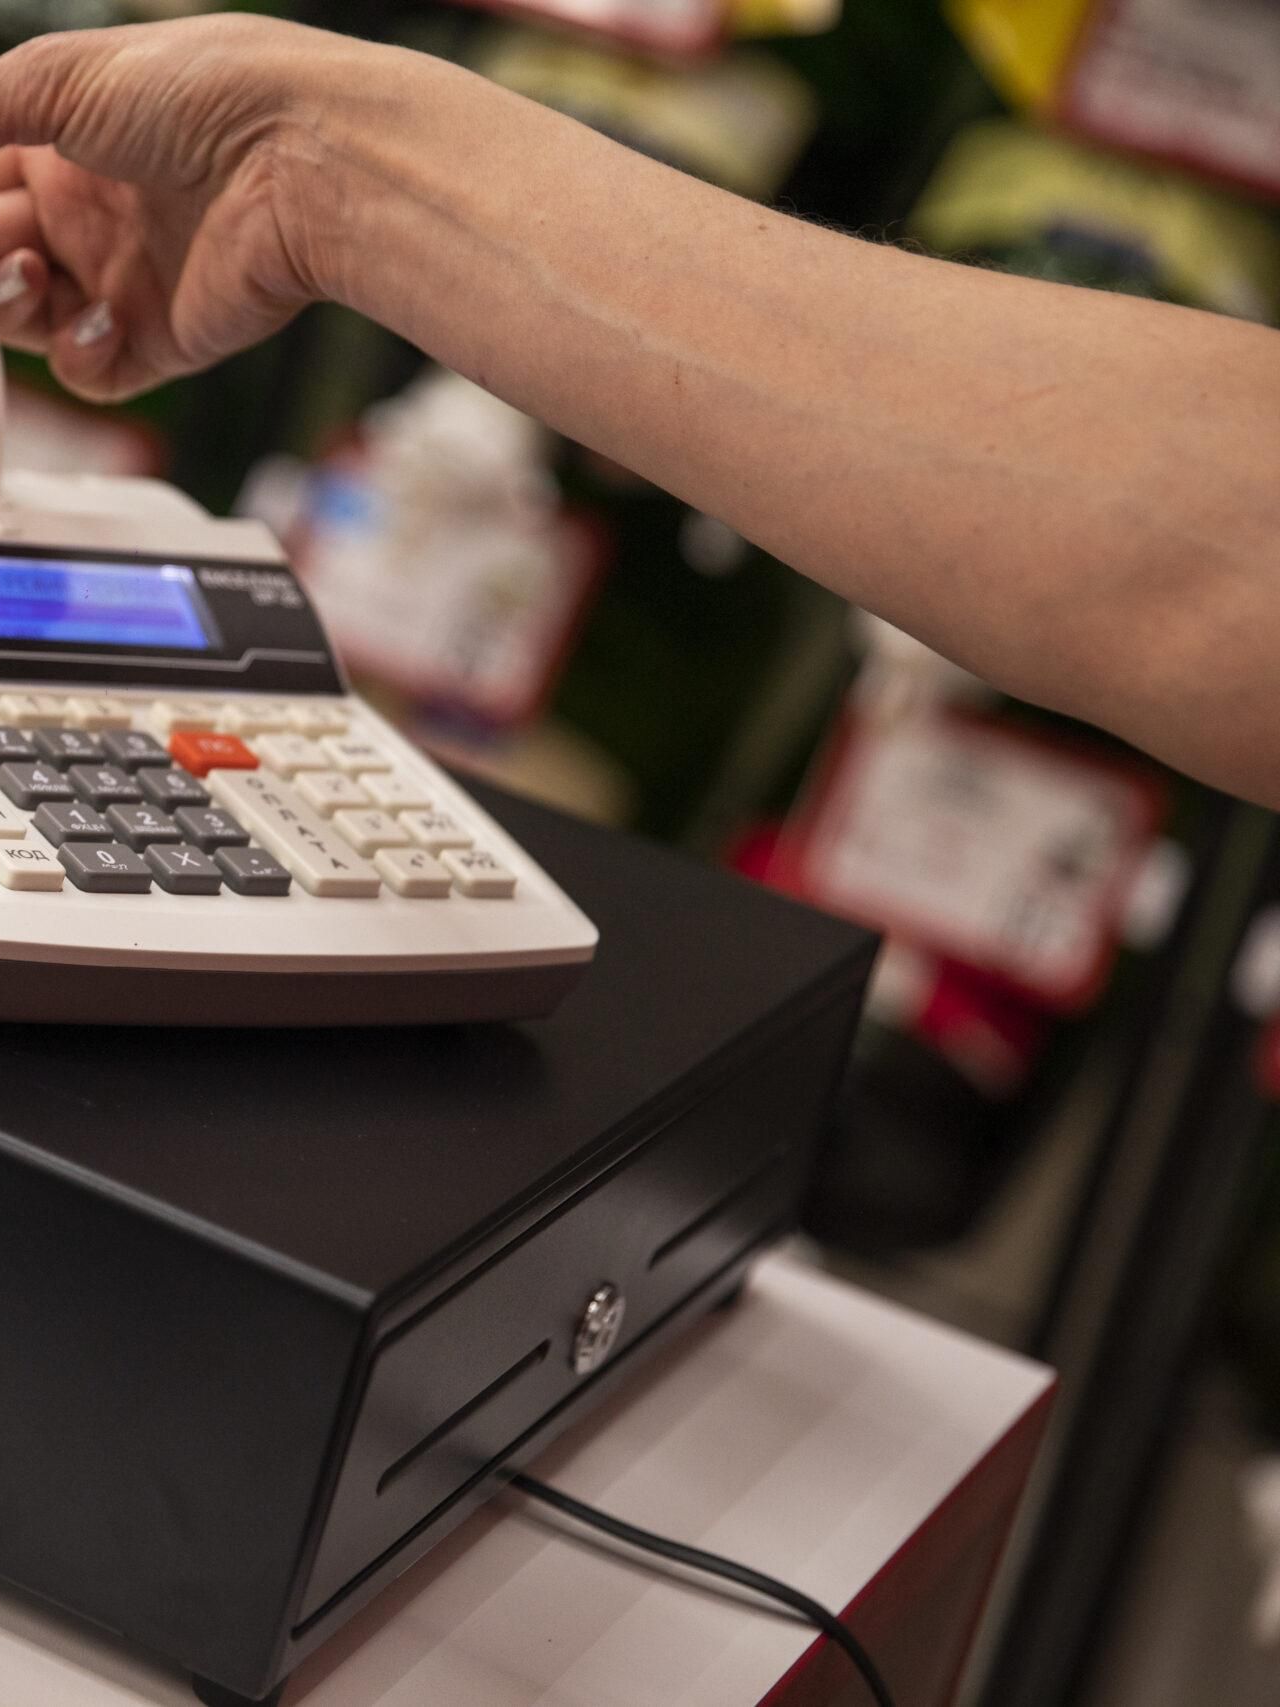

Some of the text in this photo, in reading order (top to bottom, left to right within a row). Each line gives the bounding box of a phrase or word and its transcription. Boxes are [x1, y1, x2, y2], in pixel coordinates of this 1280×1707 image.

[32, 770, 49, 784] 4
[69, 810, 87, 824] 1
[135, 811, 159, 826] 2
[204, 813, 224, 828] 3
[4, 849, 51, 862] КОД
[96, 850, 117, 865] 0
